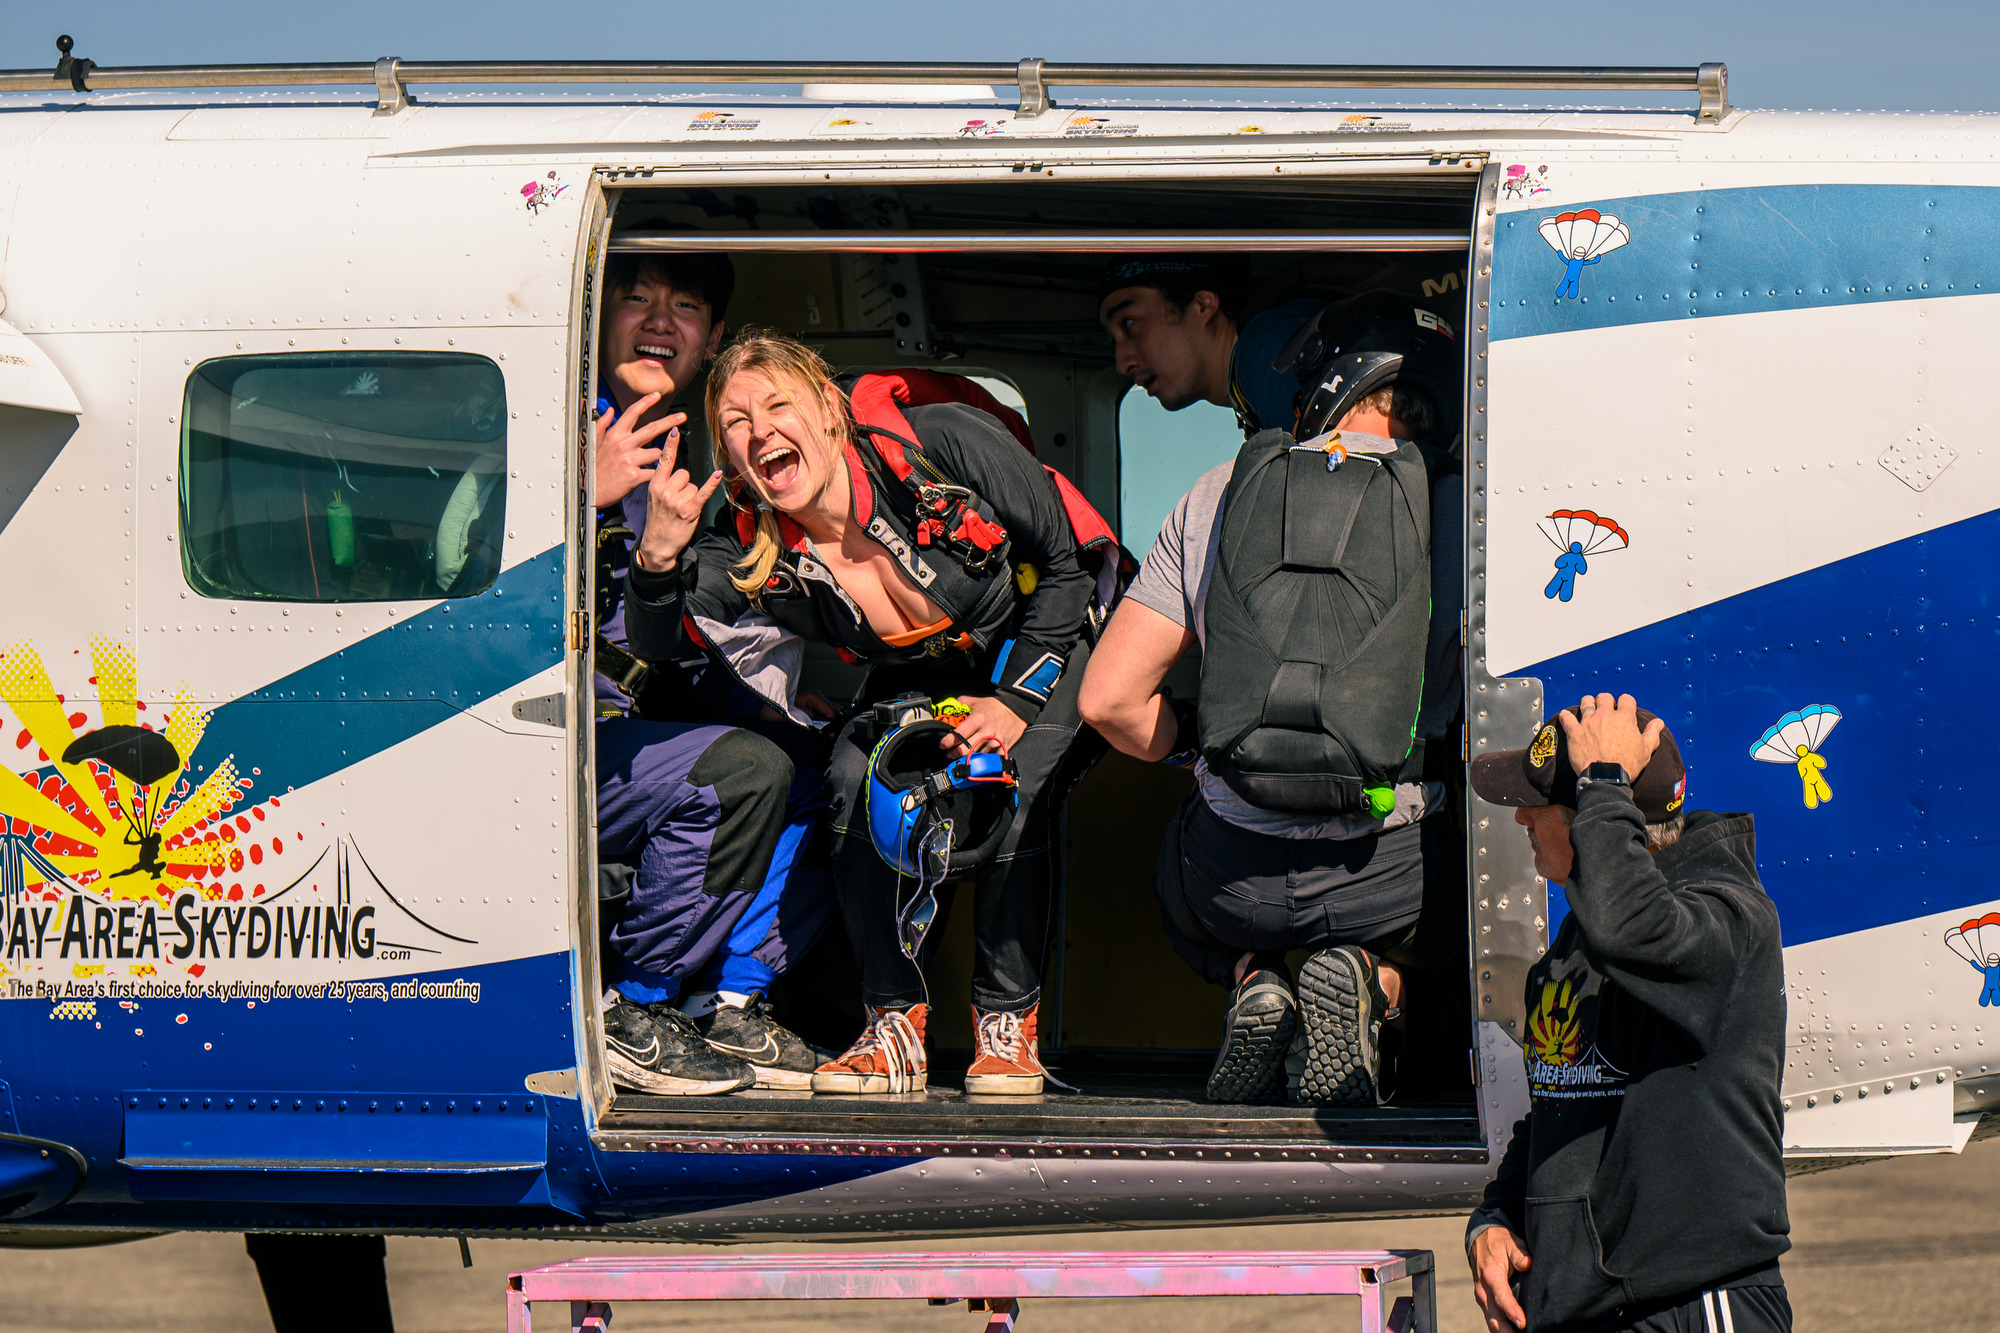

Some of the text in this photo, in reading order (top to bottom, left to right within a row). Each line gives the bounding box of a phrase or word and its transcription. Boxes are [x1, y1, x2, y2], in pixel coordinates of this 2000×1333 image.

[577, 273, 593, 611] BAY AREA SKYDIVING
[0, 895, 53, 959] AY
[60, 895, 160, 959] AREA
[172, 893, 376, 959] SKYDIVING
[8, 979, 480, 1002] The Bay Area's first choice for skydiving for over 25 years, and counting
[1532, 1060, 1559, 1085] AREA
